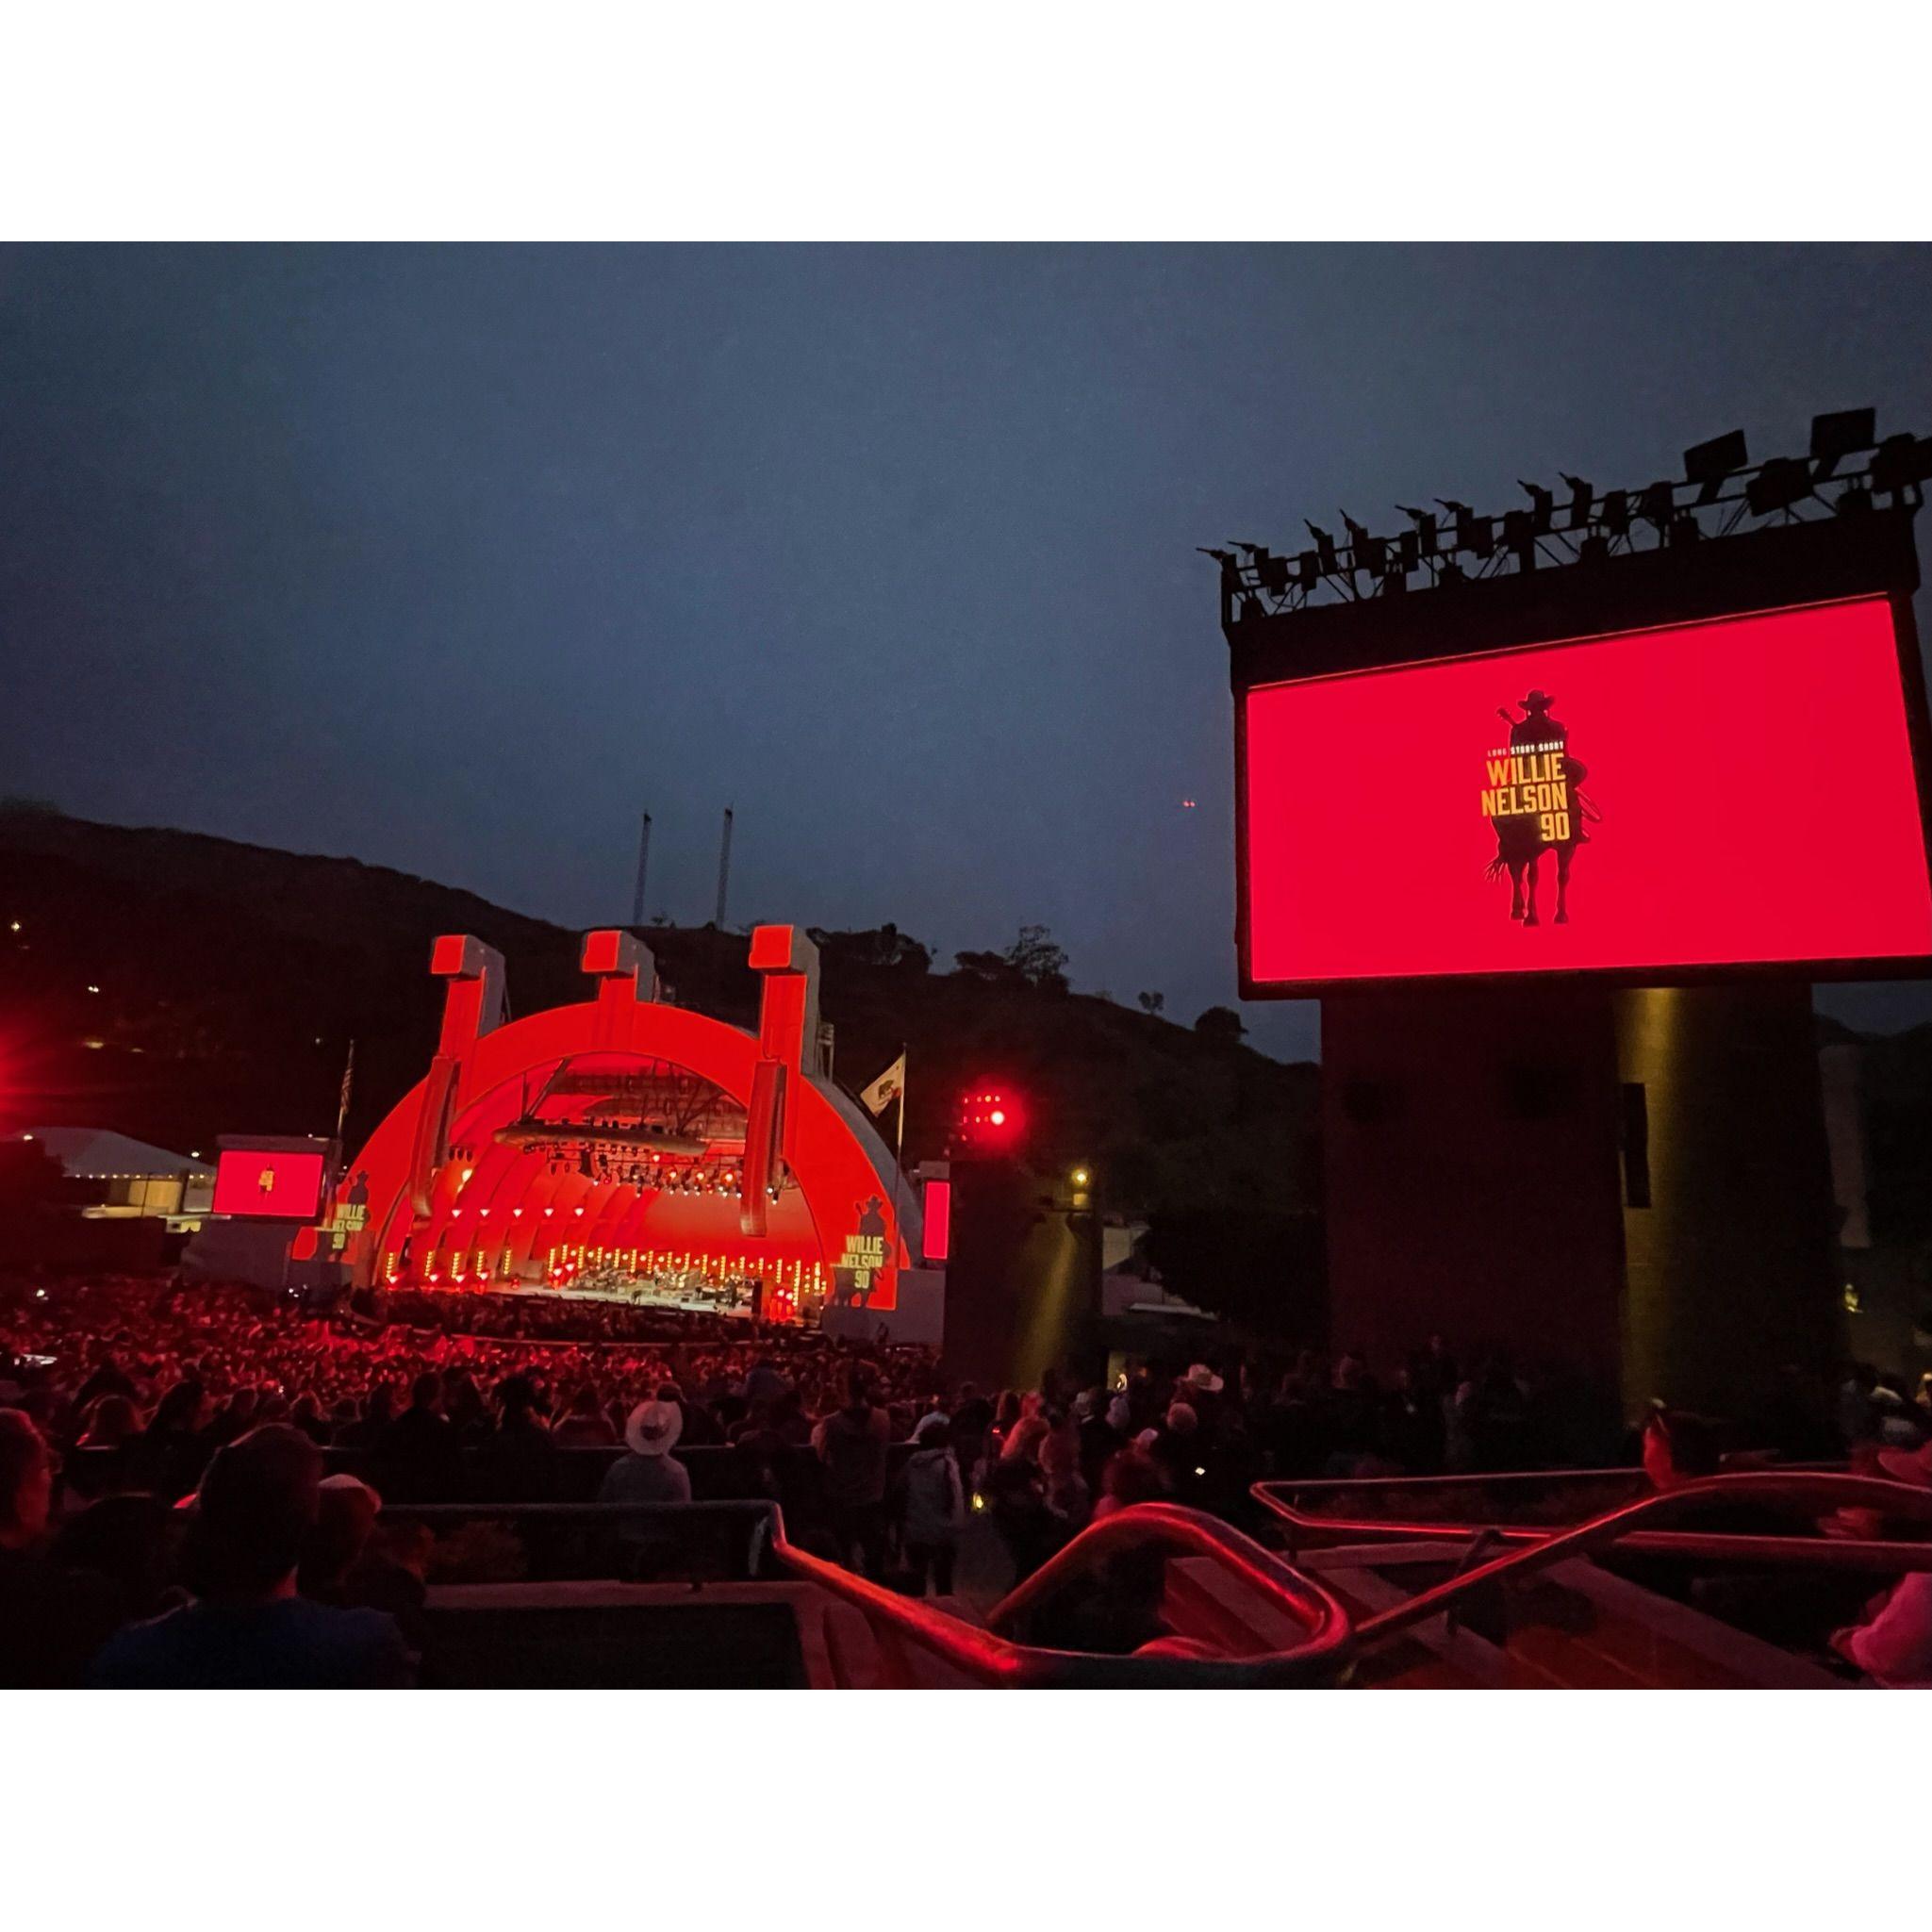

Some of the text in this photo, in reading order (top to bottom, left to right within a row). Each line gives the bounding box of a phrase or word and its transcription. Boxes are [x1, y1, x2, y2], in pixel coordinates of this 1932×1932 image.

[1486, 753, 1566, 786] WILLIE
[1481, 782, 1568, 817] NELSON
[1541, 812, 1570, 841] 90
[846, 1235, 883, 1254] WILLIE
[841, 1253, 883, 1269] NELSON
[854, 1270, 869, 1288] 90
